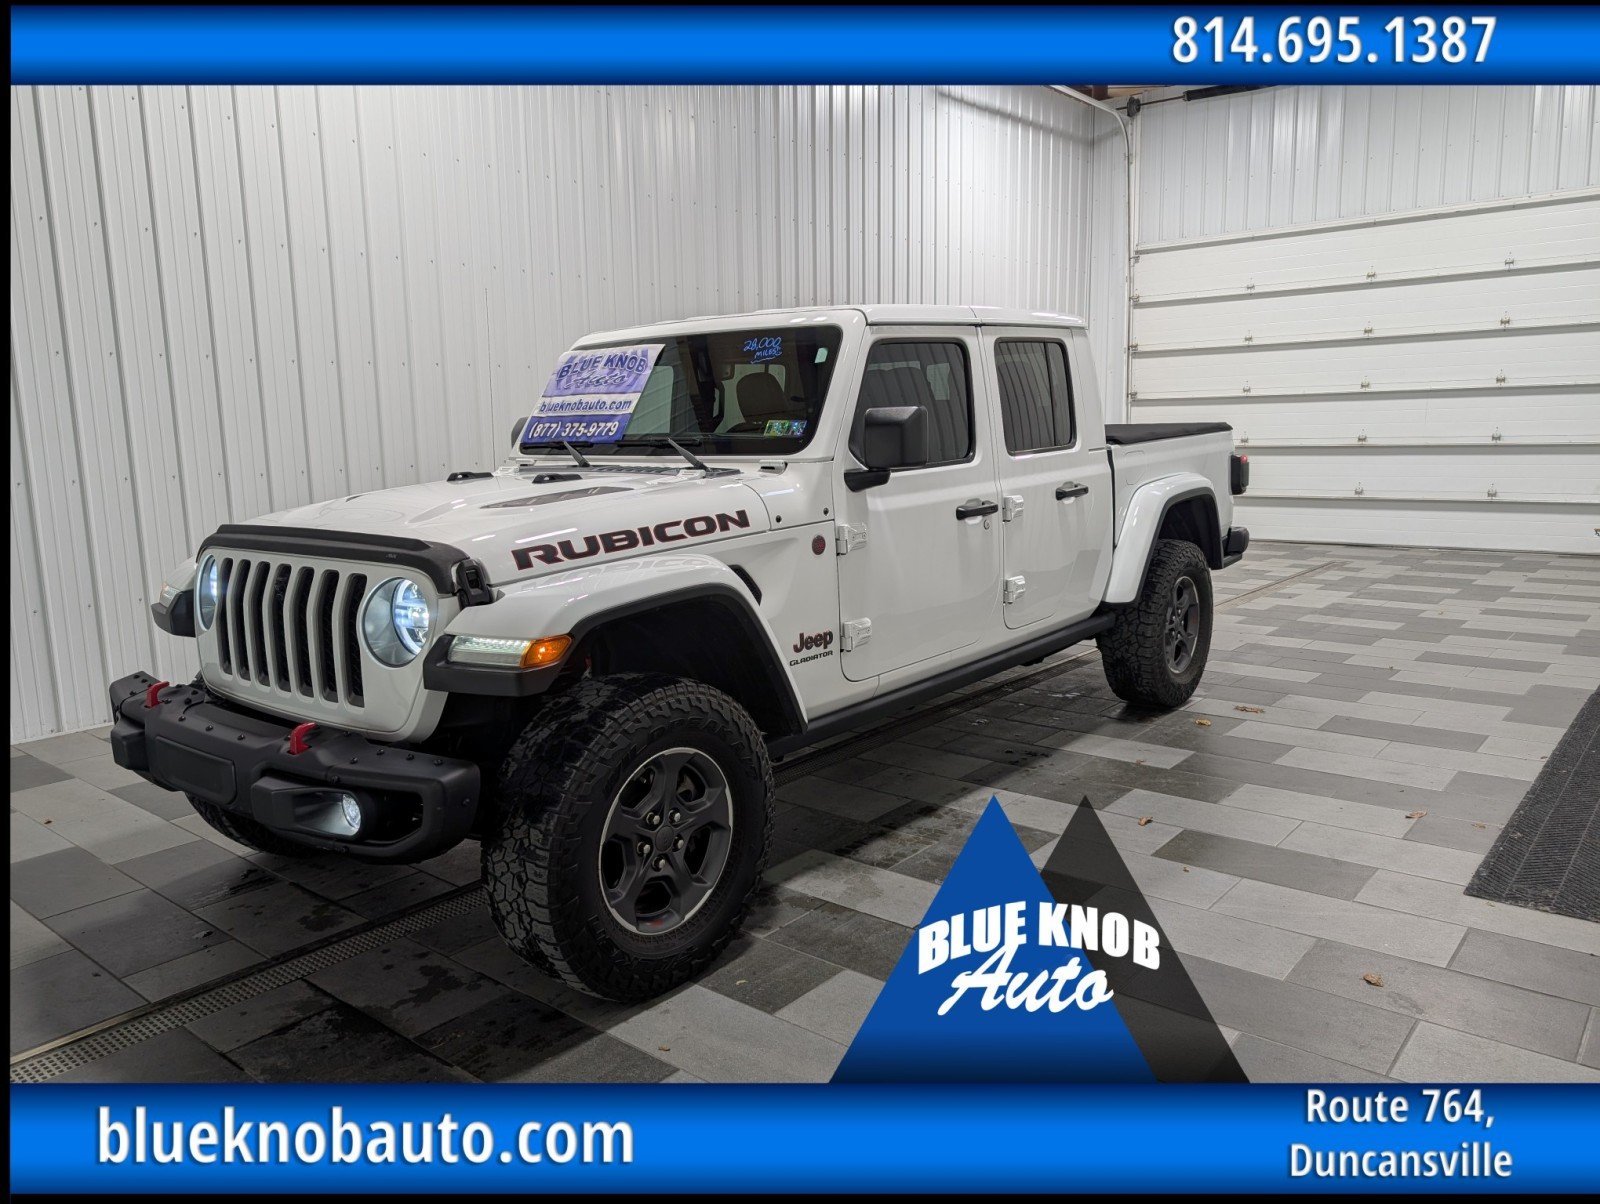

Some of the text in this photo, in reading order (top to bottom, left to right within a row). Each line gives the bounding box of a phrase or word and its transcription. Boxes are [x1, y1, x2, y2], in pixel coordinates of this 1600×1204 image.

[743, 337, 782, 351] 28,000
[557, 353, 648, 379] BLUE KNOB
[563, 370, 628, 391] Auto
[539, 399, 632, 413] blueknobauto.com
[528, 421, 620, 439] (877) 375-9779
[510, 509, 751, 571] RUBICON
[792, 630, 834, 653] Jeep
[789, 650, 834, 667] GLADIATOR
